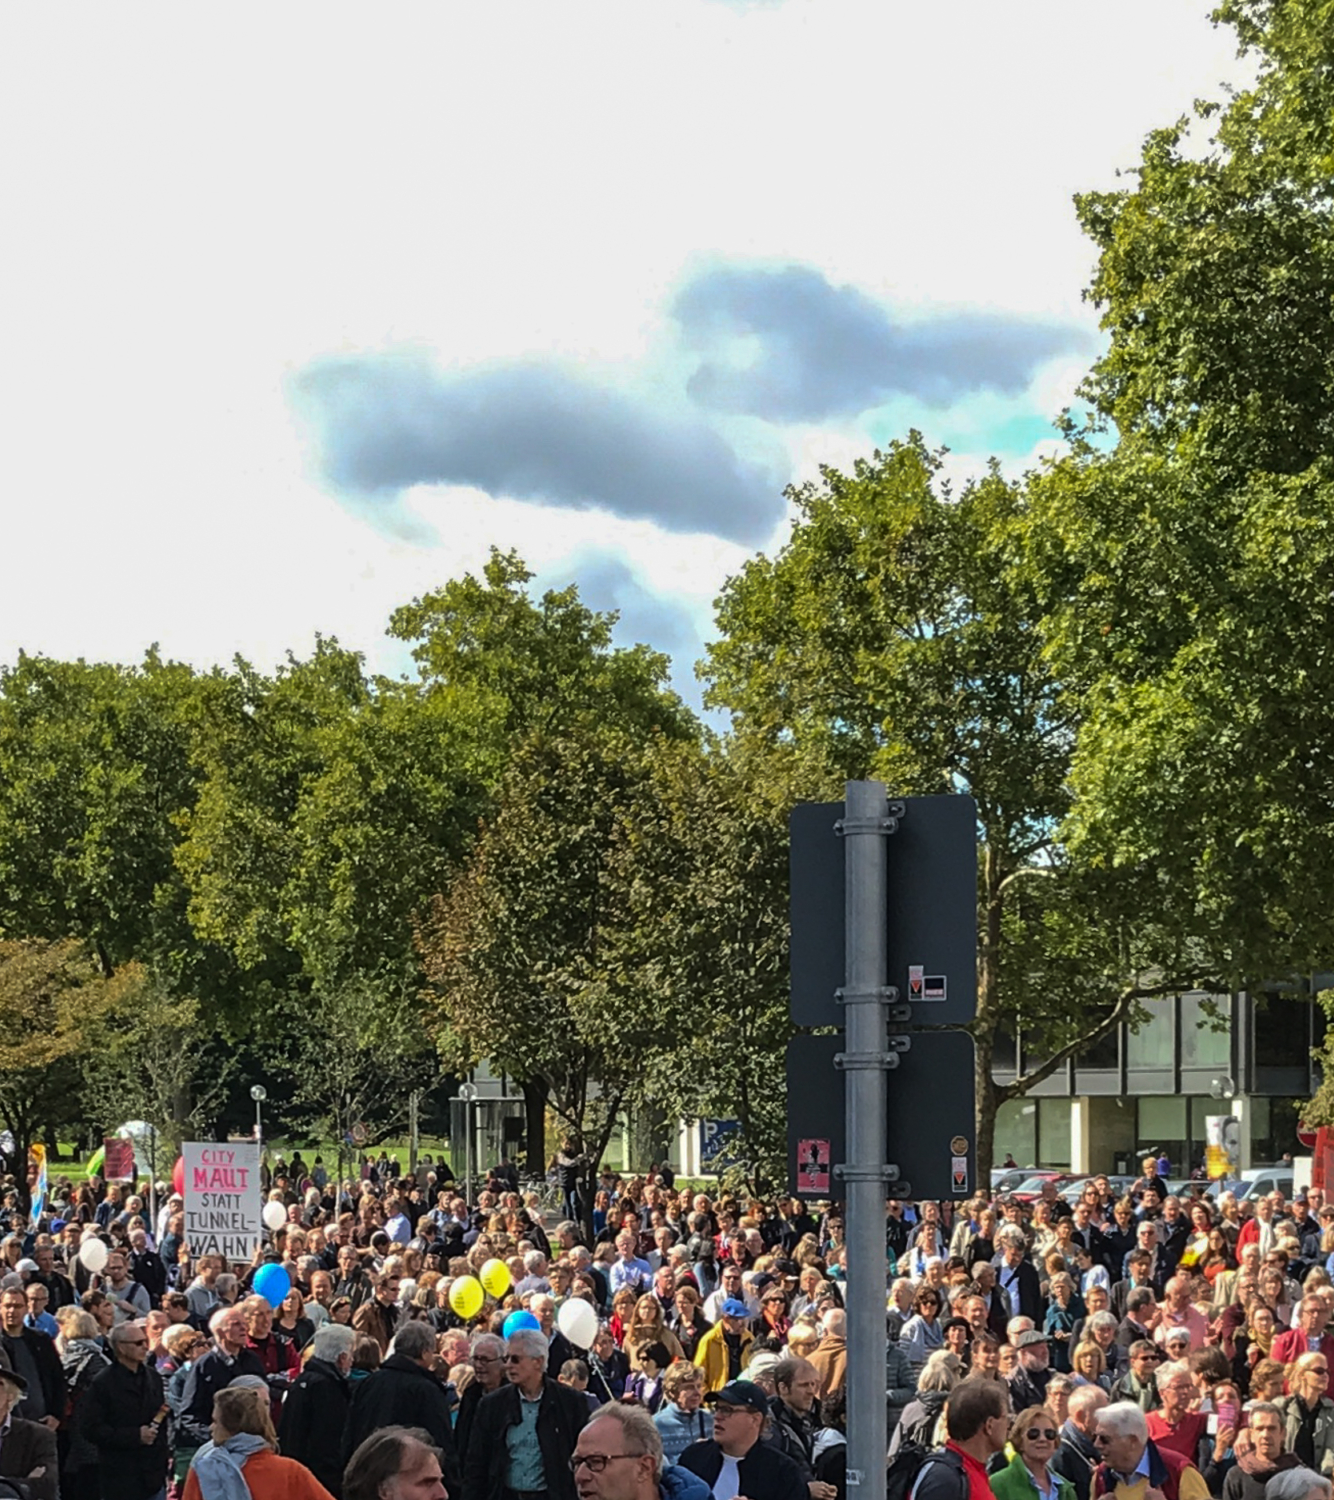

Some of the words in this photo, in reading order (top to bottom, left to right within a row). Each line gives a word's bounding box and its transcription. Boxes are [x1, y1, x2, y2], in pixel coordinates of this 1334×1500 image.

[201, 1149, 235, 1164] CITY
[193, 1167, 249, 1188] MAUT
[201, 1192, 242, 1209] STATT
[187, 1211, 257, 1231] TUNNEL-
